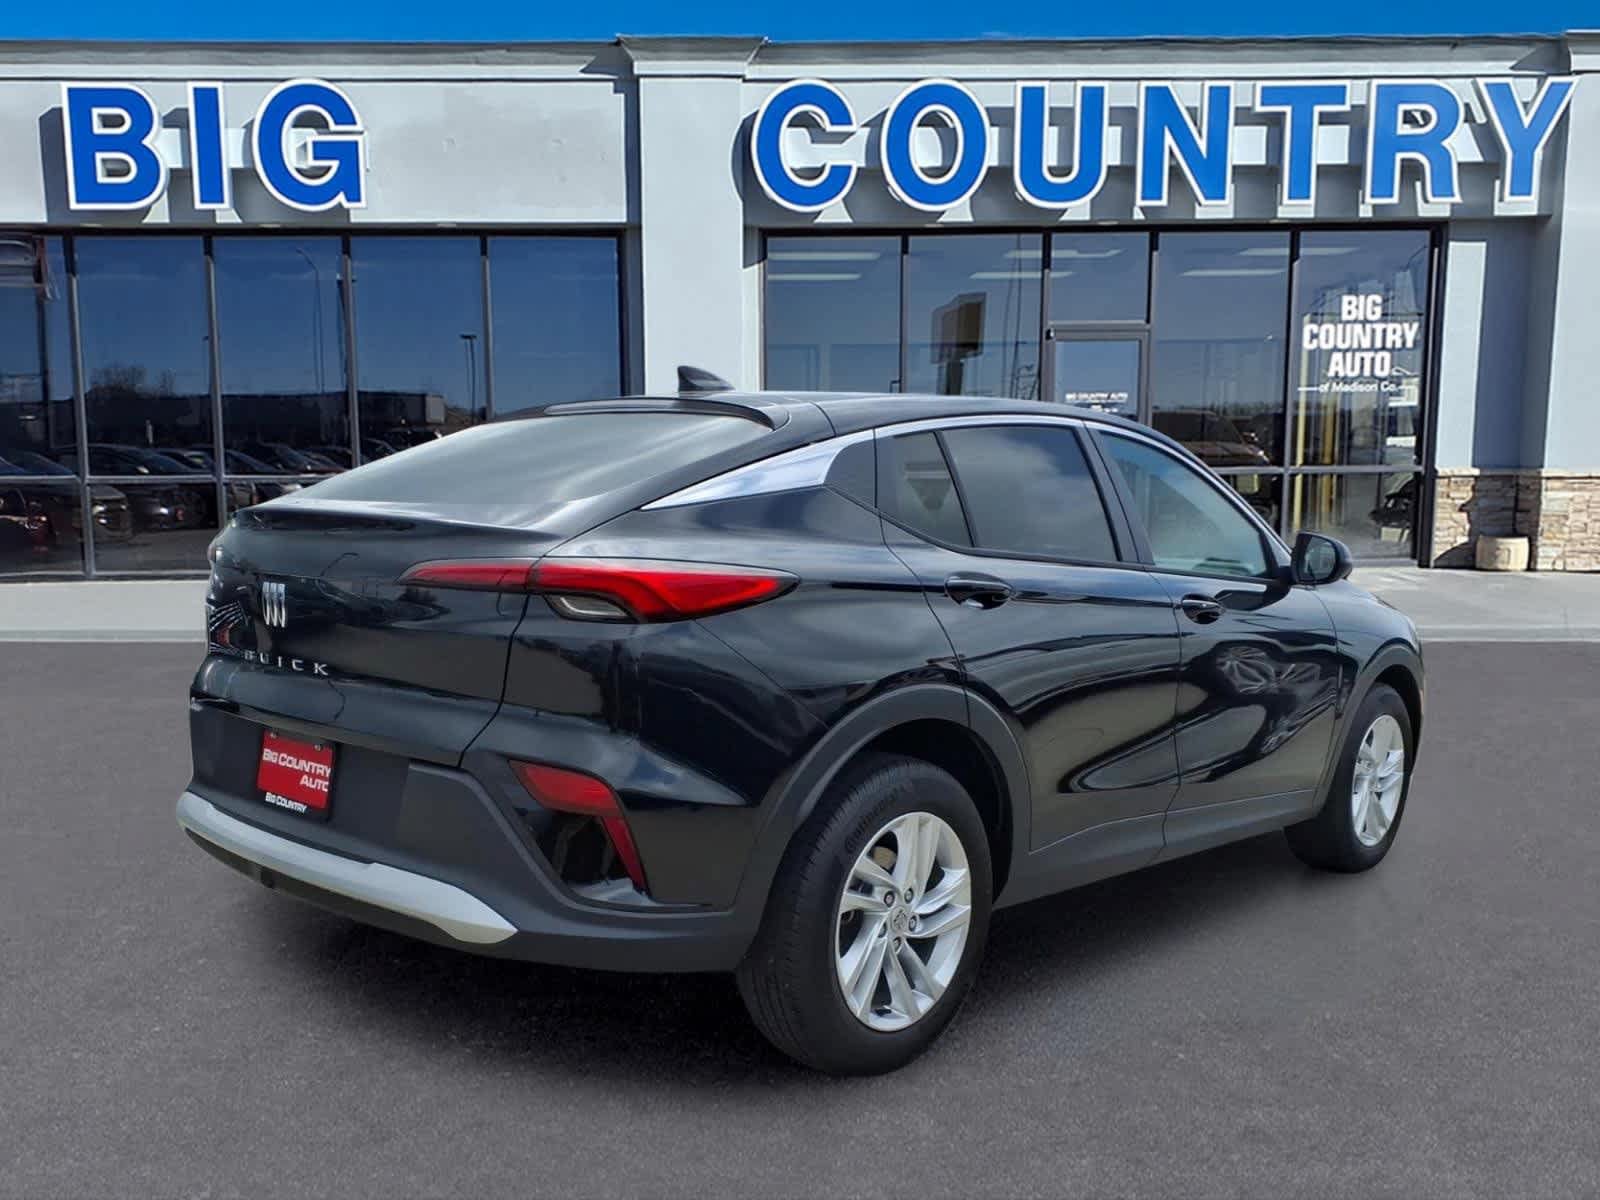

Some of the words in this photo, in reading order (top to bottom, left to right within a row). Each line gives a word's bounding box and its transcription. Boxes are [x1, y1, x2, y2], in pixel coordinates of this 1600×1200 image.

[61, 78, 367, 211] BIG
[751, 77, 1576, 213] COUNTRY
[1341, 294, 1382, 320] BIG
[1302, 322, 1420, 350] COUNTRY
[1327, 351, 1392, 377] AUTO
[1330, 382, 1378, 393] Madison
[244, 650, 329, 676] BUICK
[262, 748, 279, 764] BIG
[278, 753, 331, 777] COUNTRY
[276, 796, 307, 814] COUNTRY
